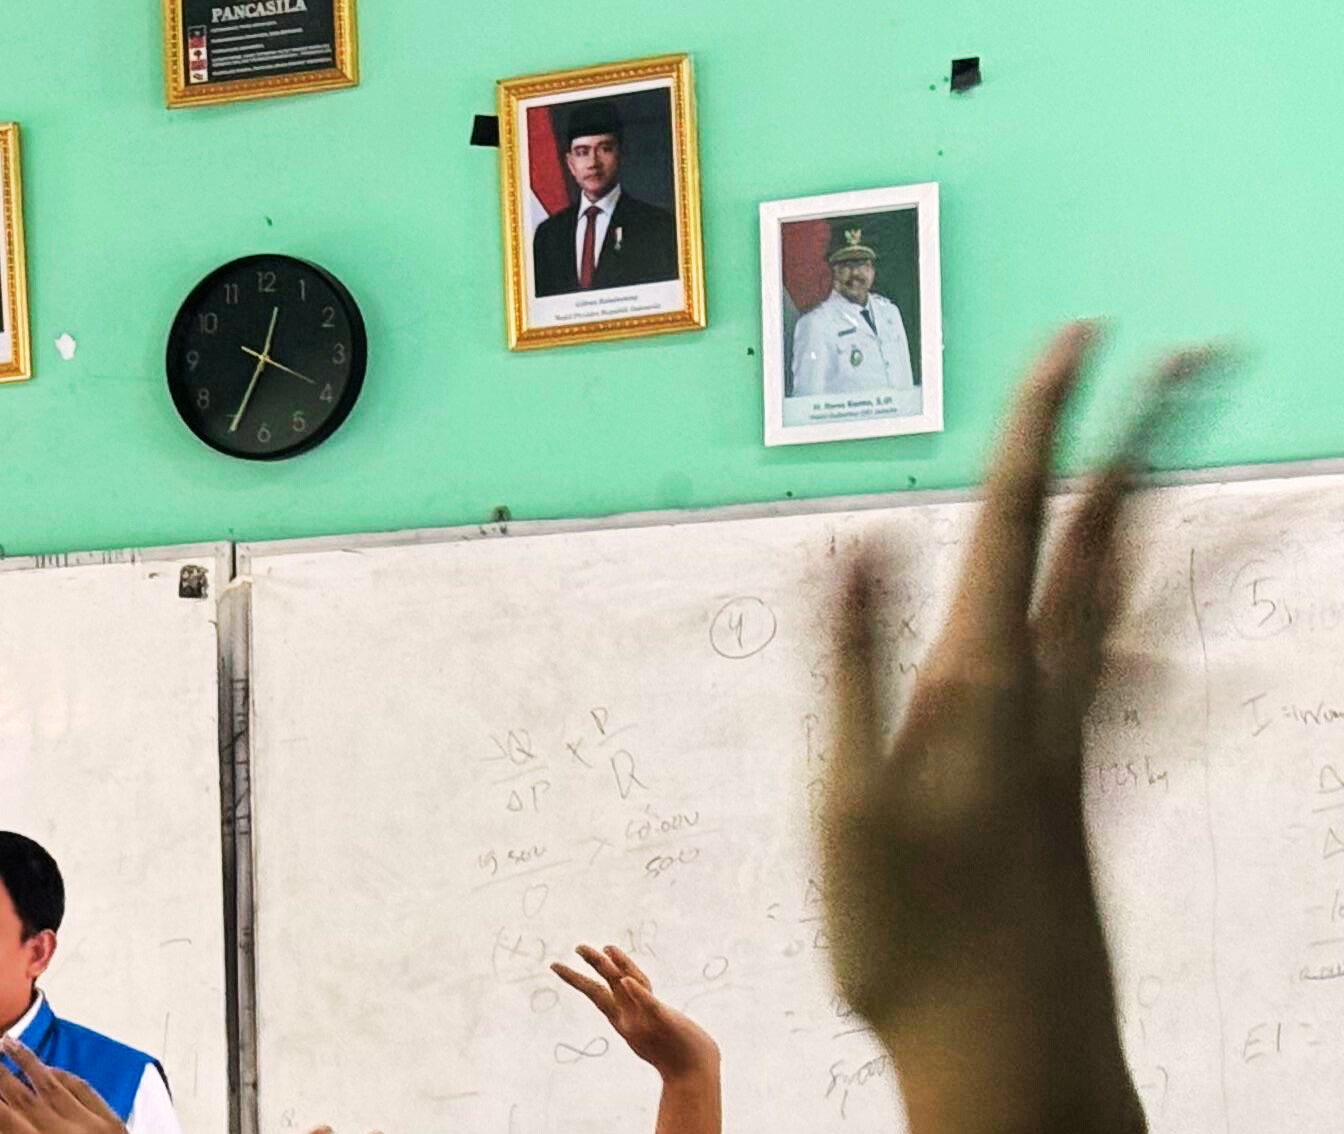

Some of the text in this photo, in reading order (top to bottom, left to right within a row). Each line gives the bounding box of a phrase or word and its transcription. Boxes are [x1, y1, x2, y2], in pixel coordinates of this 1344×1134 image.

[212, 0, 307, 23] PANCASILA
[257, 272, 277, 293] 12
[224, 283, 239, 304] 11
[199, 313, 218, 334] 10
[322, 306, 335, 327] 2
[186, 351, 199, 370] 9
[332, 343, 346, 364] 3
[197, 389, 210, 409] 8
[320, 383, 334, 403] 4
[292, 410, 305, 431] 5
[257, 424, 271, 442] 6
